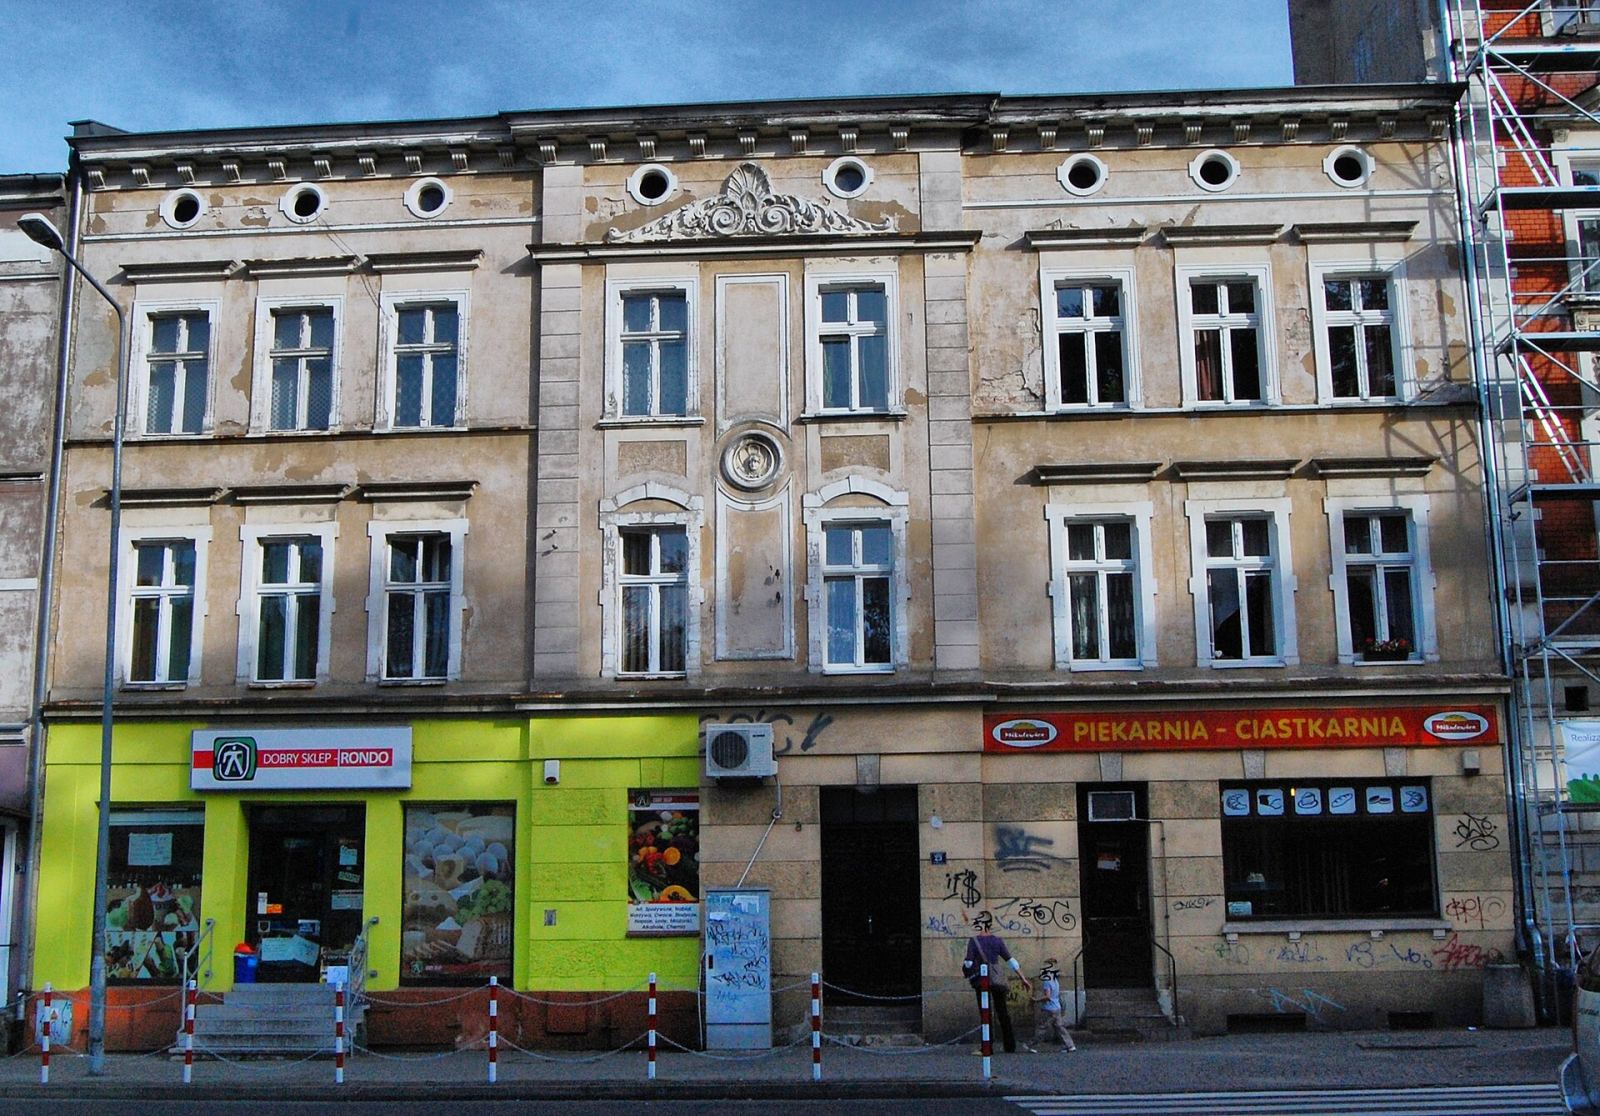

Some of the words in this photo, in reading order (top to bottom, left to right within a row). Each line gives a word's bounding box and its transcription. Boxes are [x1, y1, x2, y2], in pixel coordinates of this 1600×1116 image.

[1073, 719, 1210, 742] PIEKARNIA
[1235, 716, 1407, 740] CIASTKARNIA
[263, 753, 299, 764] DOBRY
[301, 752, 332, 764] SKLEP
[340, 751, 389, 764] RONDO
